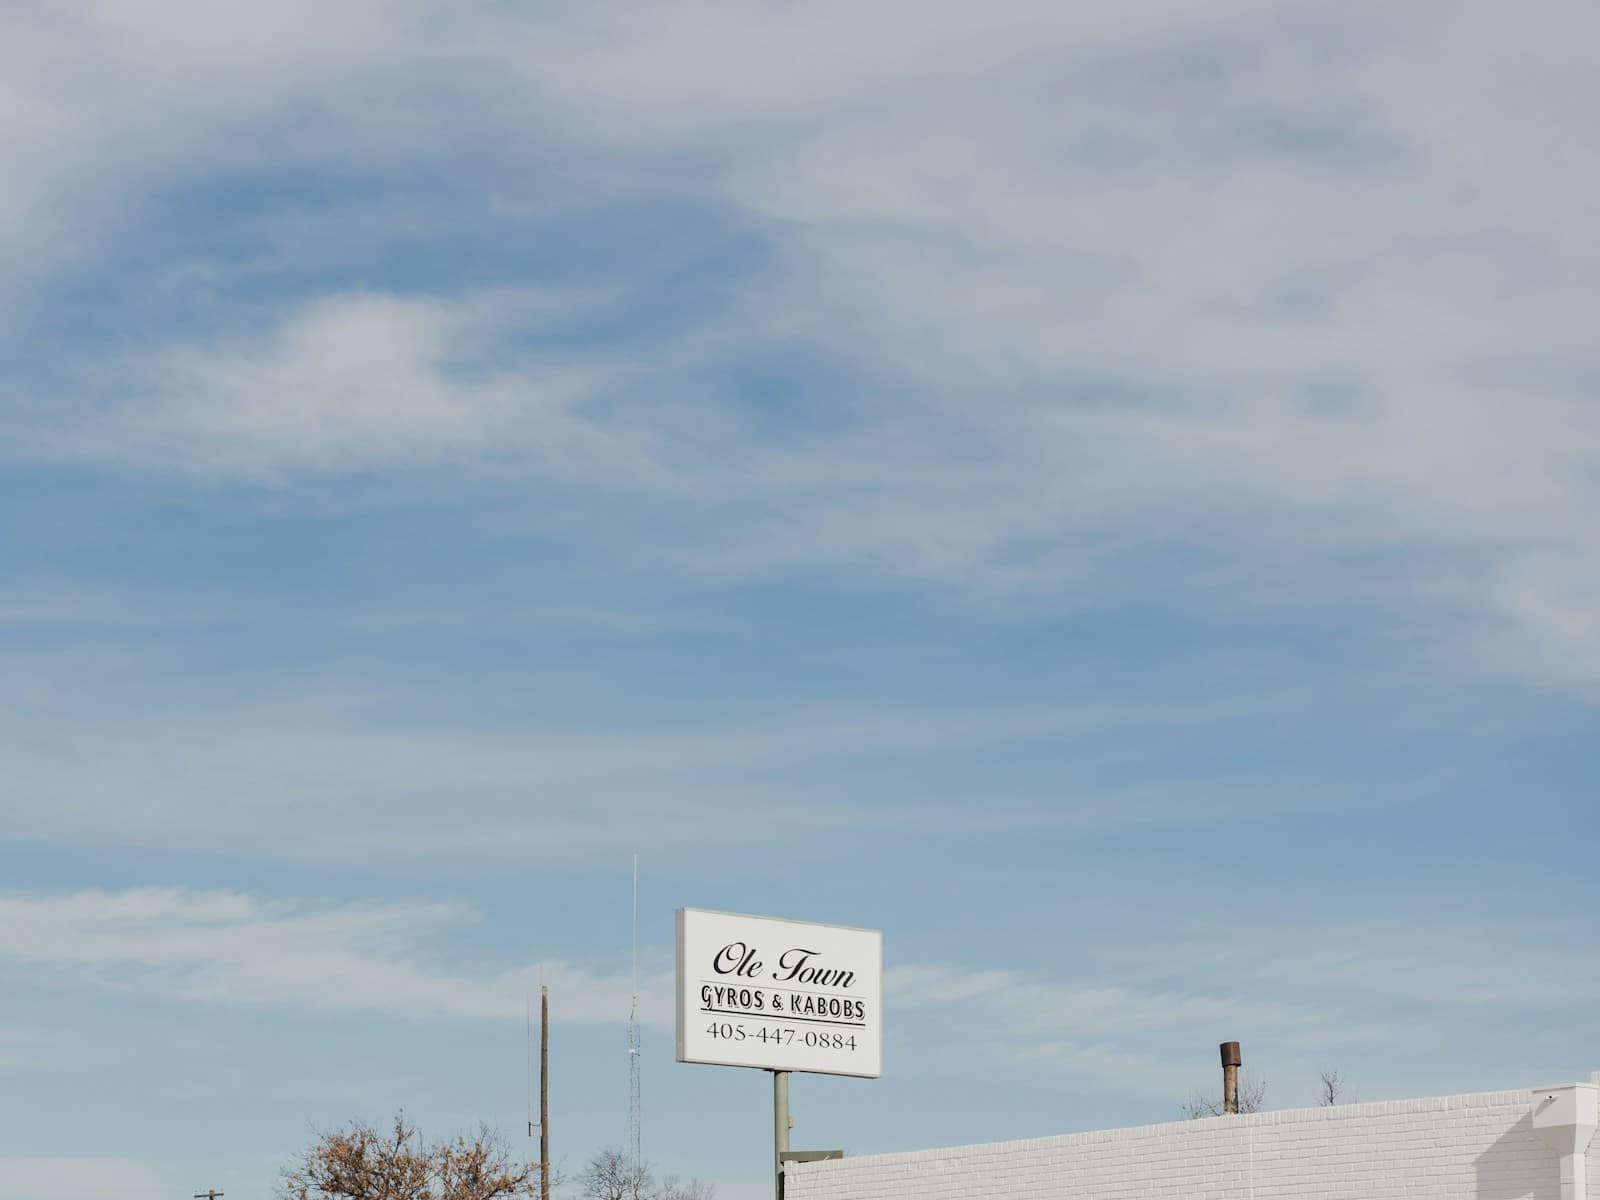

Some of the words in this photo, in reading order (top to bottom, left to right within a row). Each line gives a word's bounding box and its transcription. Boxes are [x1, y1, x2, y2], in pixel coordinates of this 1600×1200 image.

[713, 941, 764, 978] Ole
[772, 948, 857, 988] Town
[701, 985, 764, 1010] GYROS
[772, 994, 784, 1011] &
[790, 994, 865, 1020] KABOBS
[706, 1022, 858, 1051] 405-447-0884
